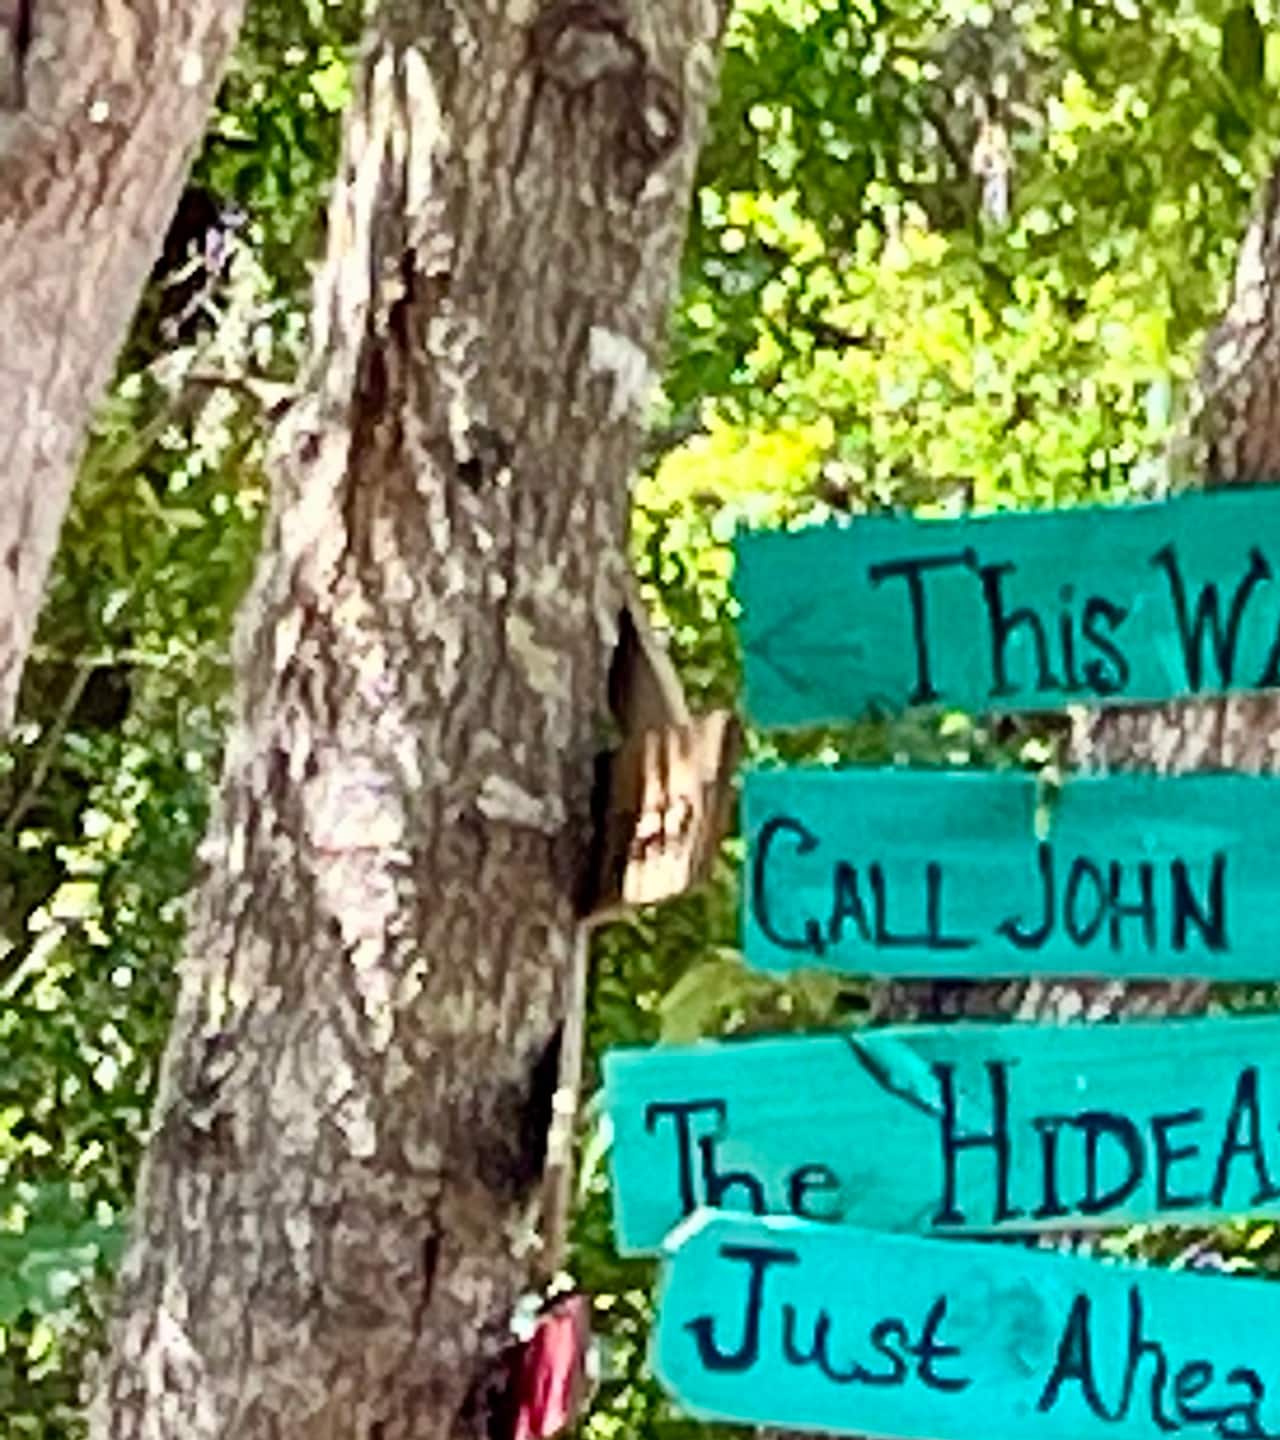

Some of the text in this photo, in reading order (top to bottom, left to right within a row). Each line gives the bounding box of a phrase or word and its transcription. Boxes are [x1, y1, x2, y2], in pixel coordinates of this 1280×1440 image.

[868, 546, 1131, 706] This
[750, 816, 1230, 956] CALL JOHN
[644, 1098, 844, 1222] The
[685, 1244, 972, 1392] Just
